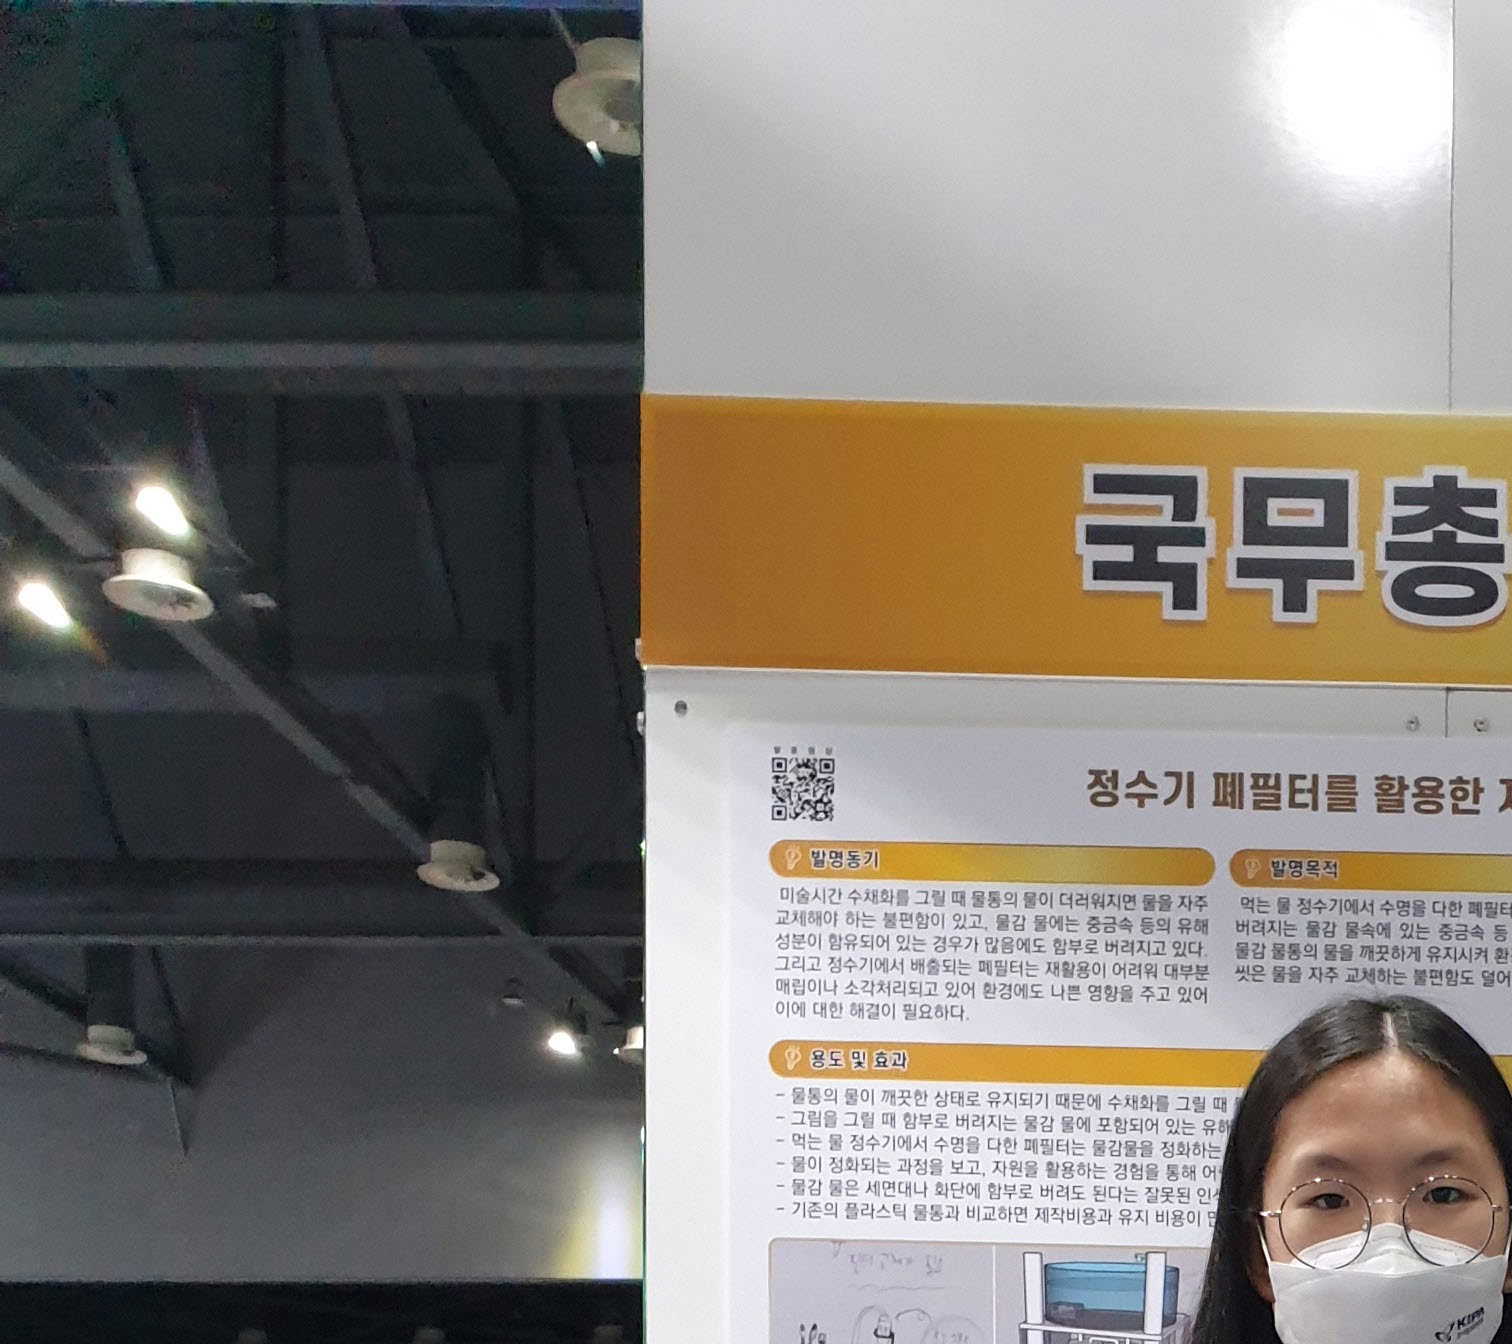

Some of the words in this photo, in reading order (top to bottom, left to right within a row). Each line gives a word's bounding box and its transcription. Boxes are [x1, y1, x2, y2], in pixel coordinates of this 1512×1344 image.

[1087, 768, 1194, 809] 정수기
[1212, 771, 1358, 812] 폐필터를
[1374, 774, 1484, 815] 활용한
[811, 849, 879, 870] 발명동기
[1271, 859, 1338, 878] 발명목적
[780, 886, 842, 905] 미술시간
[847, 888, 909, 906] 수채화를
[914, 889, 945, 907] 그릴
[951, 890, 965, 907] 때
[971, 890, 1017, 909] 물통의
[1023, 891, 1053, 909] 물이
[1059, 892, 1136, 910] 더러워지면
[1142, 894, 1172, 911] 물을
[1177, 895, 1207, 912] 자주
[1241, 896, 1270, 914] 먹는
[1297, 898, 1374, 916] 정수기에서
[1380, 899, 1426, 917] 수명을
[1432, 900, 1462, 918] 다한
[775, 909, 838, 927] 교체해야
[845, 910, 876, 928] 하는
[883, 911, 944, 929] 불편함이
[952, 912, 987, 930] 있고,
[995, 914, 1026, 931] 물감
[1033, 914, 1079, 933] 물에는
[1086, 915, 1133, 934] 중금속
[1140, 917, 1170, 935] 등의
[1177, 918, 1208, 935] 유해
[1235, 919, 1297, 937] 버려지는
[1306, 920, 1336, 938] 물감
[1346, 921, 1390, 939] 물속에
[1399, 922, 1430, 940] 있는
[1438, 923, 1484, 941] 중금속
[1493, 924, 1507, 942] 등
[811, 1050, 844, 1069] 용도
[850, 1050, 866, 1069] 및
[874, 1051, 908, 1070] 효과
[792, 1087, 837, 1105] 물통의
[844, 1088, 874, 1105] 물이
[881, 1088, 928, 1107] 깨끗한
[934, 1090, 980, 1108] 상태로
[987, 1091, 1048, 1109] 유지되기
[1055, 1092, 1101, 1111] 때문에
[1108, 1094, 1169, 1112] 수채화를
[1175, 1096, 1205, 1113] 그릴
[1213, 1097, 1227, 1113] 때
[792, 1133, 822, 1150] 먹는
[829, 1134, 843, 1151] 물
[850, 1134, 927, 1152] 정수기에서
[934, 1135, 980, 1154] 수명을
[987, 1136, 1017, 1154] 다한
[1024, 1137, 1085, 1156] 폐필터는
[1092, 1139, 1153, 1157] 물감물을
[1160, 1140, 1222, 1162] 정화하는
[792, 1155, 821, 1173] 물이
[829, 1156, 890, 1175] 정화되는
[897, 1158, 943, 1175] 과정을
[950, 1159, 985, 1177] 보고,
[992, 1160, 1038, 1178] 자원을
[1045, 1160, 1107, 1180] 활용하는
[1113, 1162, 1159, 1181] 경험을
[1166, 1164, 1196, 1182] 통해
